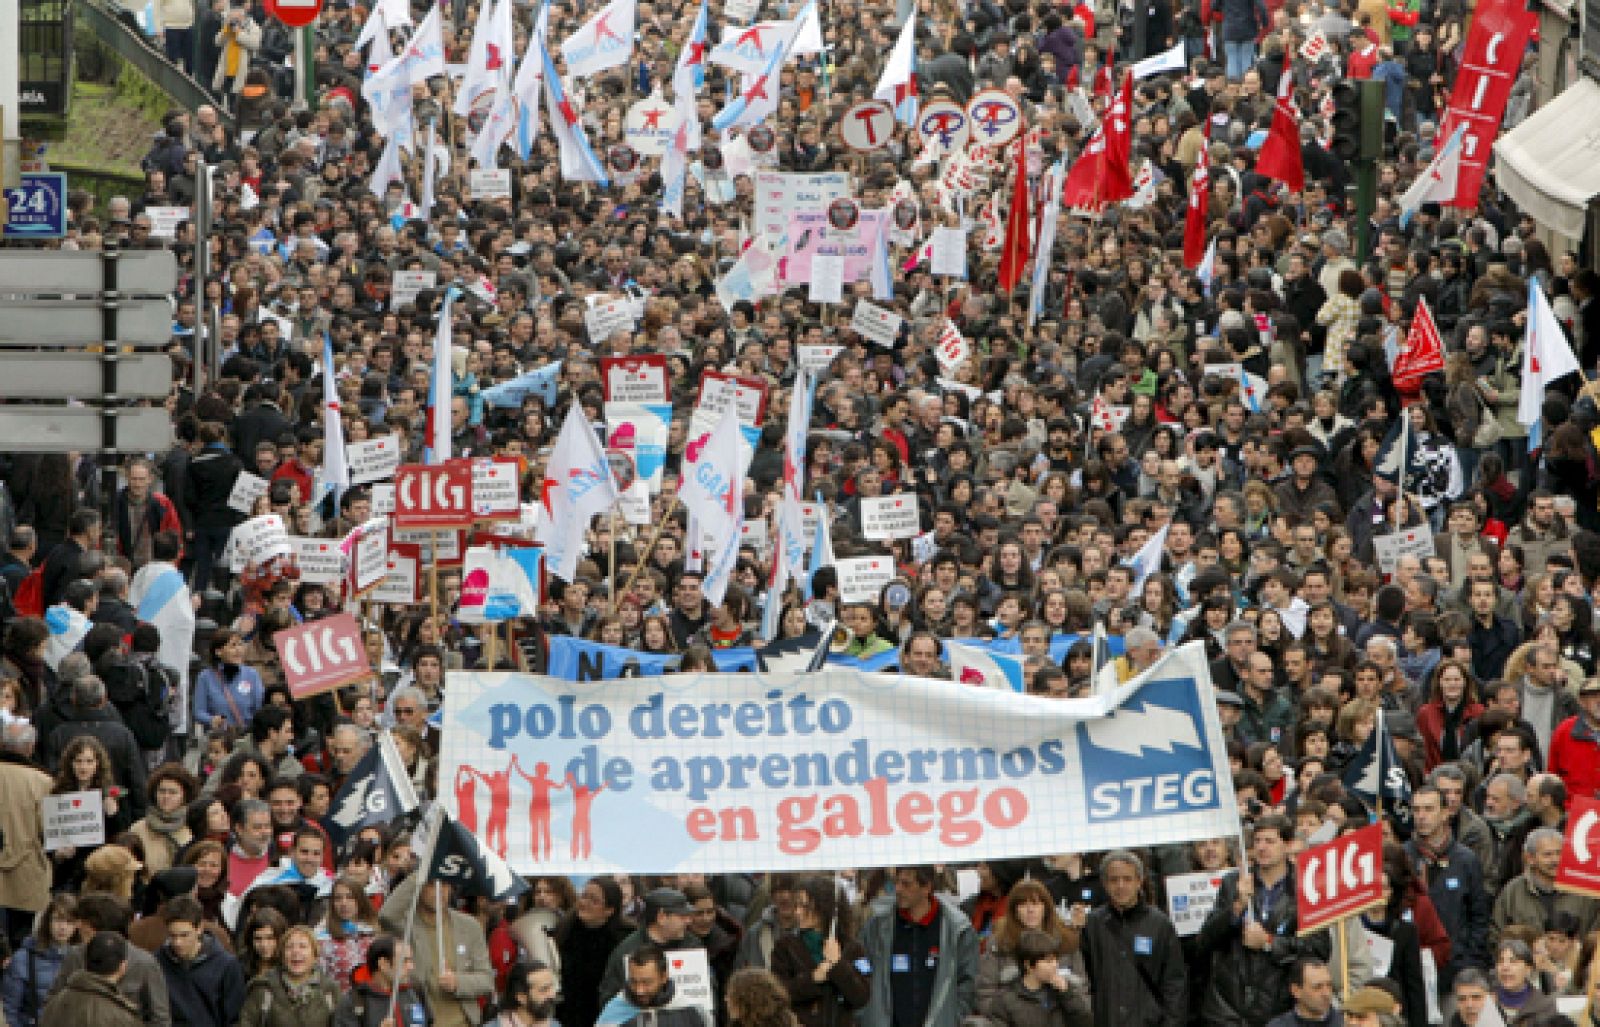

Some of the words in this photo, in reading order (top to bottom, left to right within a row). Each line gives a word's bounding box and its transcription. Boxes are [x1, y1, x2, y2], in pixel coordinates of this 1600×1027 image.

[11, 189, 47, 213] 24
[400, 470, 466, 510] CIG
[284, 627, 358, 677] CIG
[488, 694, 613, 750] polo
[629, 689, 853, 739] dereito
[565, 744, 634, 792] de
[650, 738, 1066, 803] aprendermos
[1090, 769, 1212, 818] STEG
[685, 804, 760, 842] en
[776, 776, 1029, 856] galego
[1302, 841, 1374, 906] CIG
